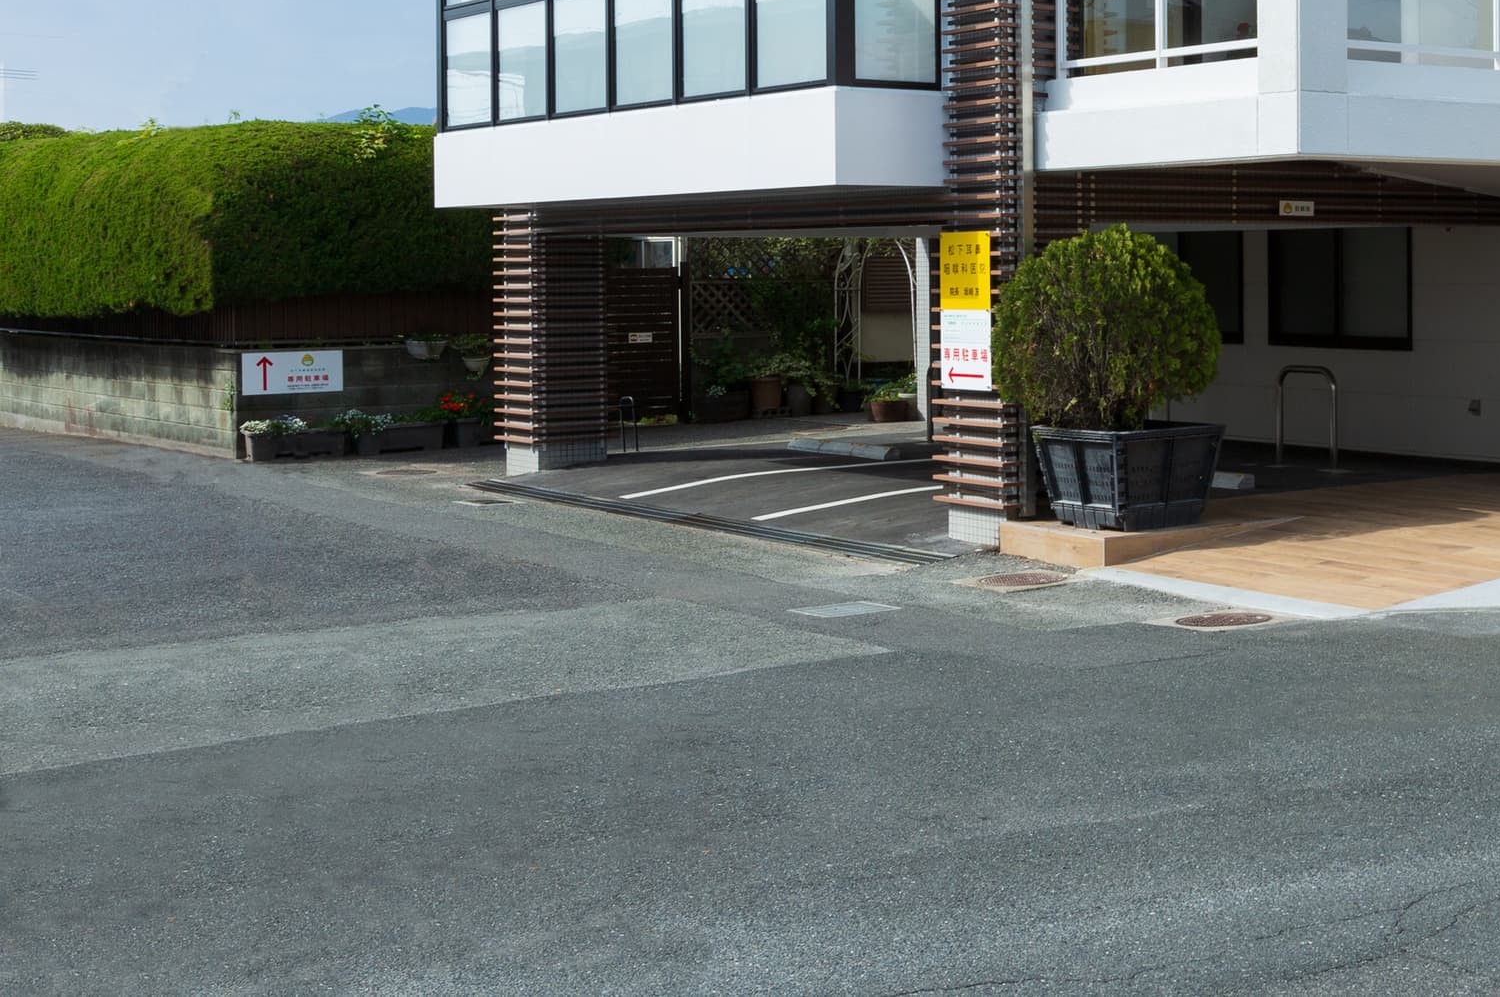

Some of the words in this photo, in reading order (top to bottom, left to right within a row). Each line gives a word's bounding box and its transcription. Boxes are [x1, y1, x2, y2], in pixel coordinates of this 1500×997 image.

[943, 347, 988, 362] 専用駐車場
